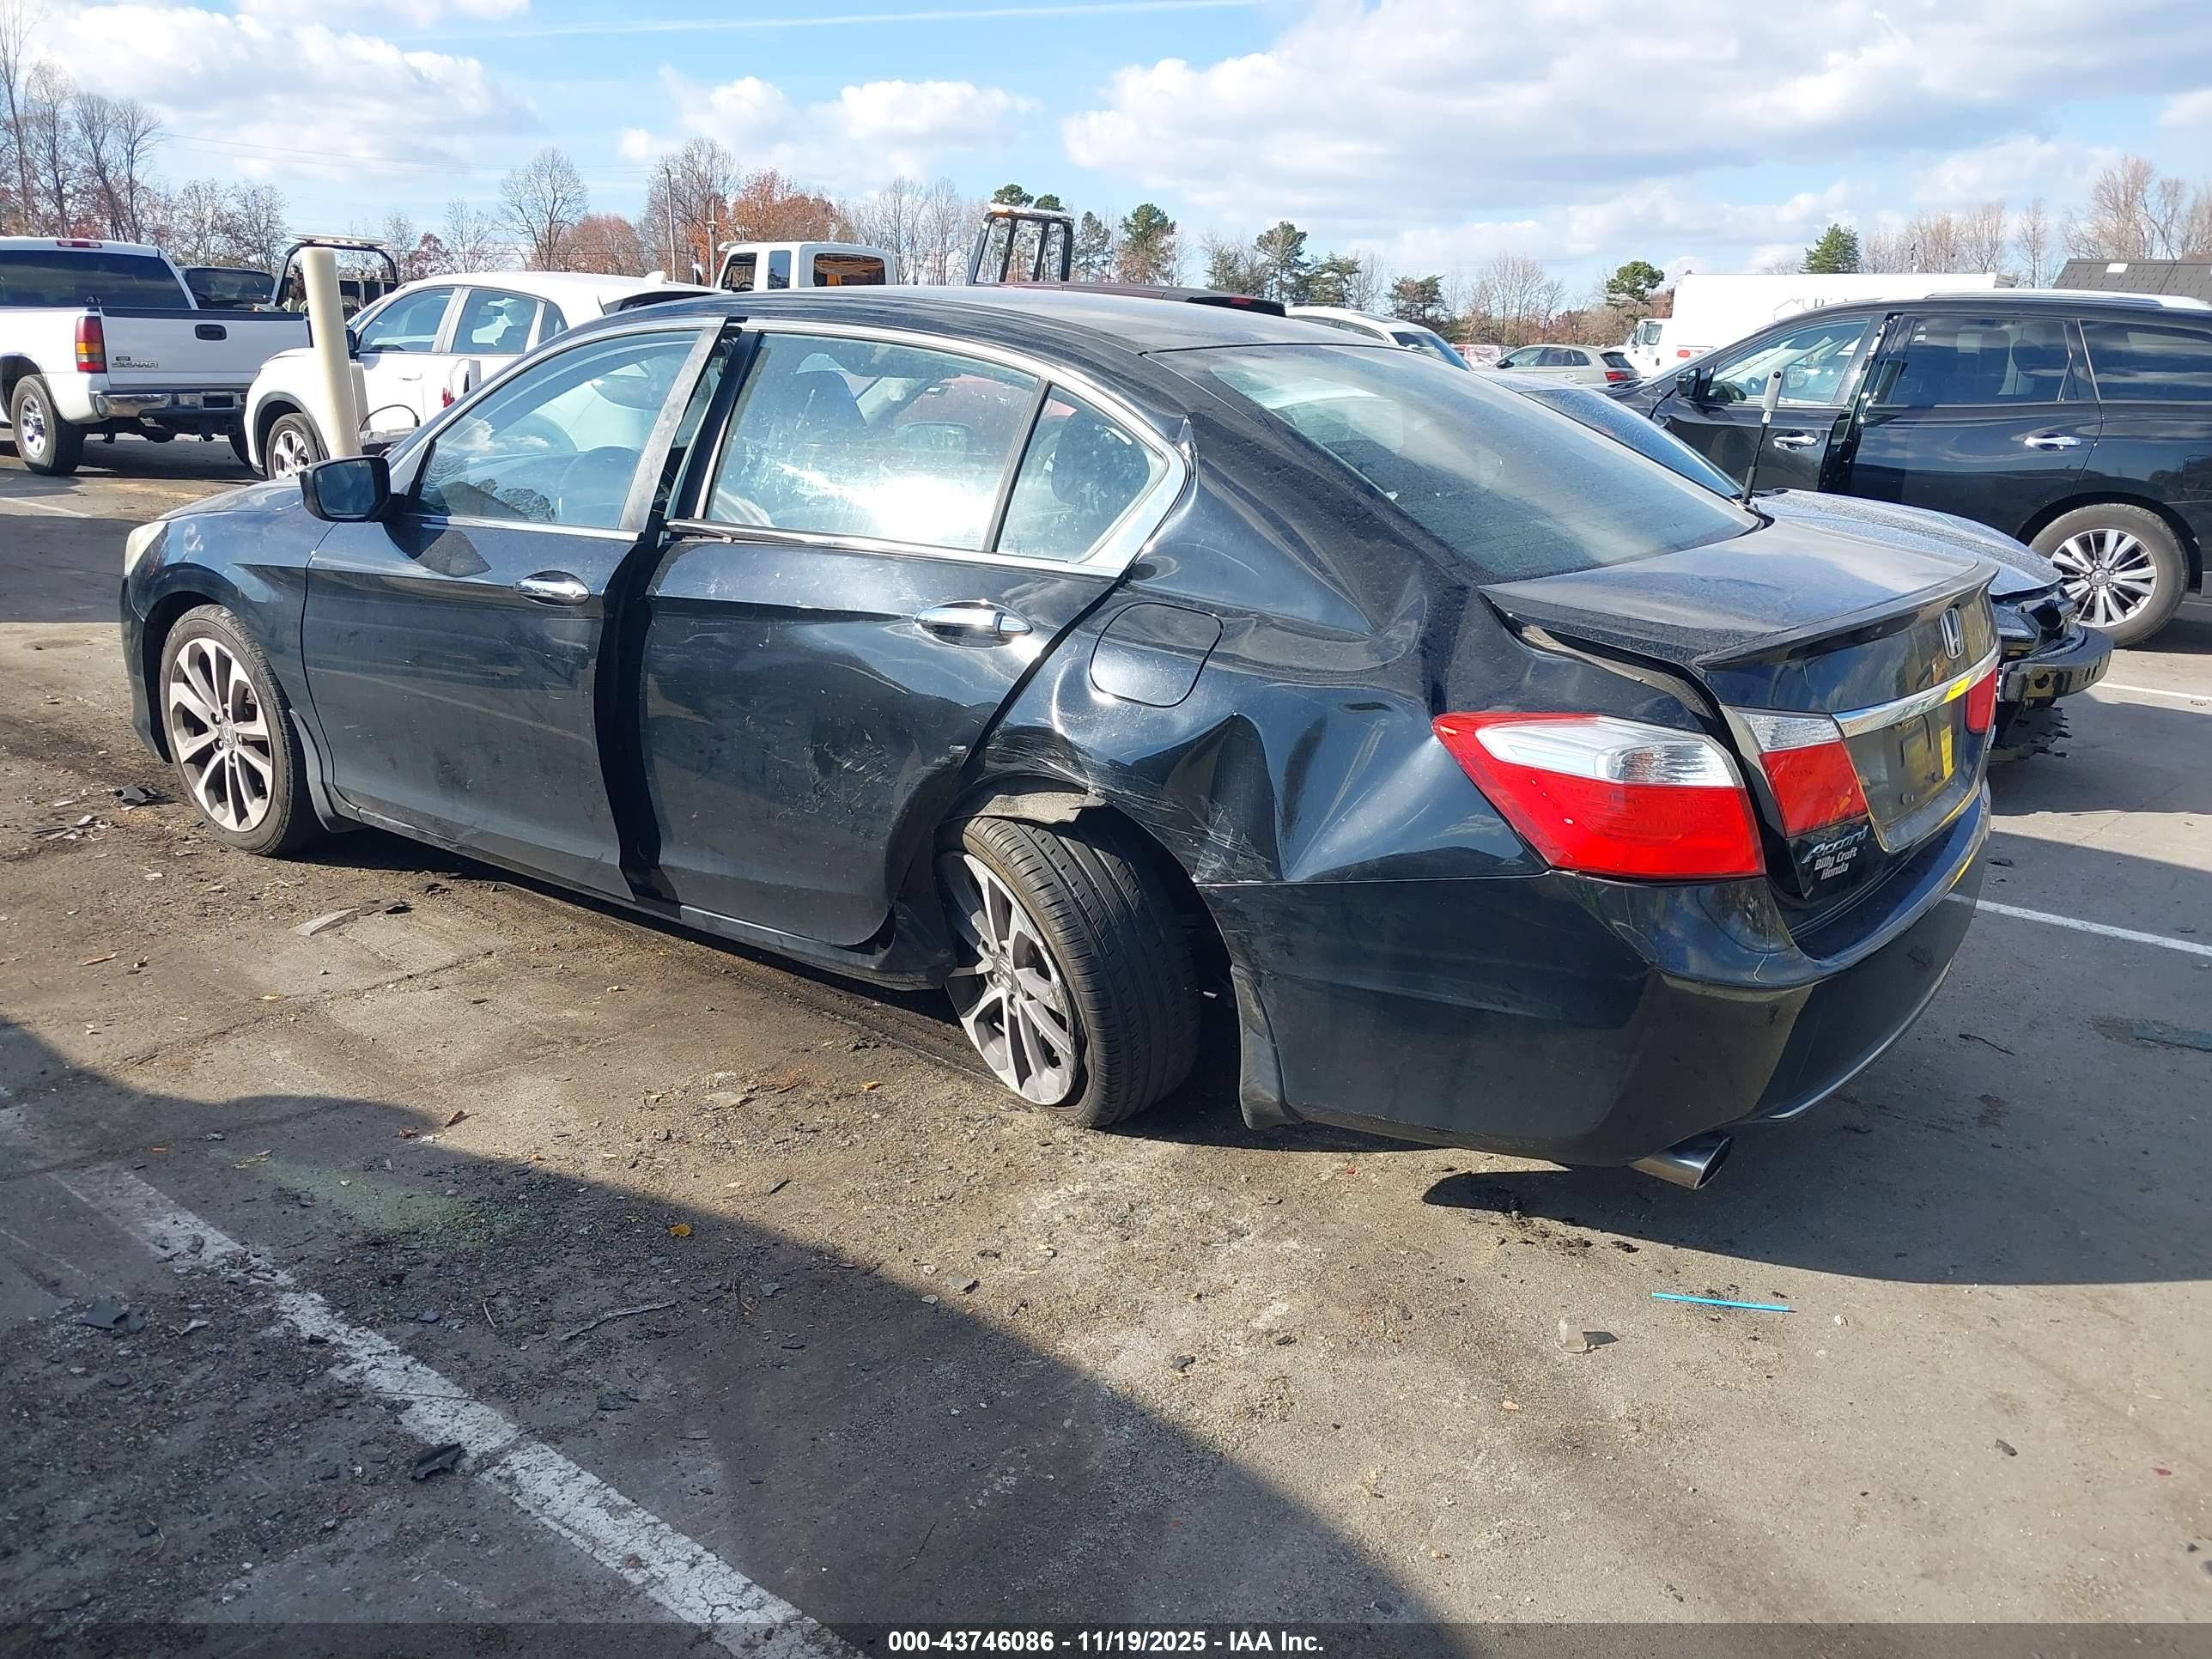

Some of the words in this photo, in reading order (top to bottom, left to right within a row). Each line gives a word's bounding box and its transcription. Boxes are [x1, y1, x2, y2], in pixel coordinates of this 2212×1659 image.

[1814, 855, 1835, 871] Billy
[1836, 847, 1858, 863] Craft
[1820, 861, 1850, 880] Honda
